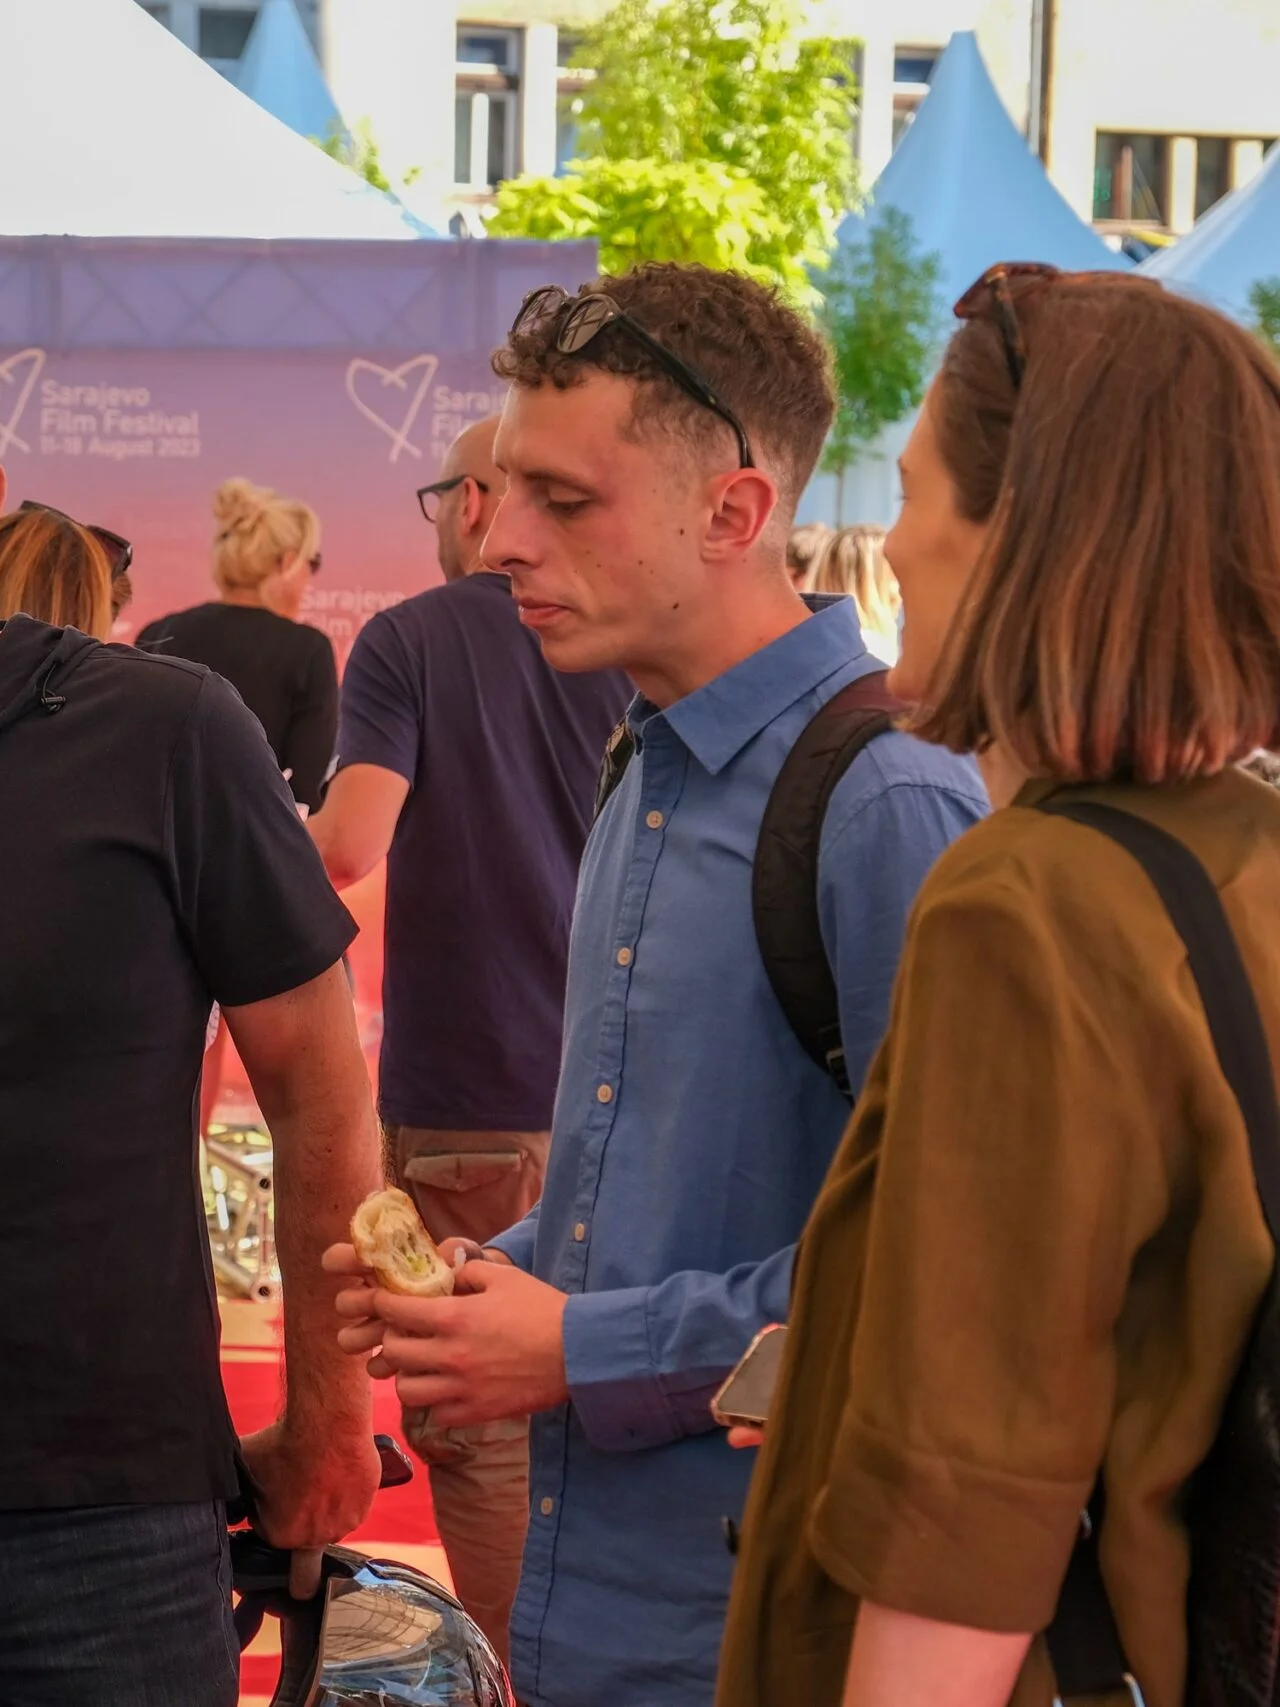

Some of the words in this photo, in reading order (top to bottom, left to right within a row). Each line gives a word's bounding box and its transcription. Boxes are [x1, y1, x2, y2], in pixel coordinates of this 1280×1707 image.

[40, 379, 151, 413] Sarajevo
[40, 408, 97, 434] Film
[103, 408, 200, 436] Festival
[431, 413, 476, 438] Fil
